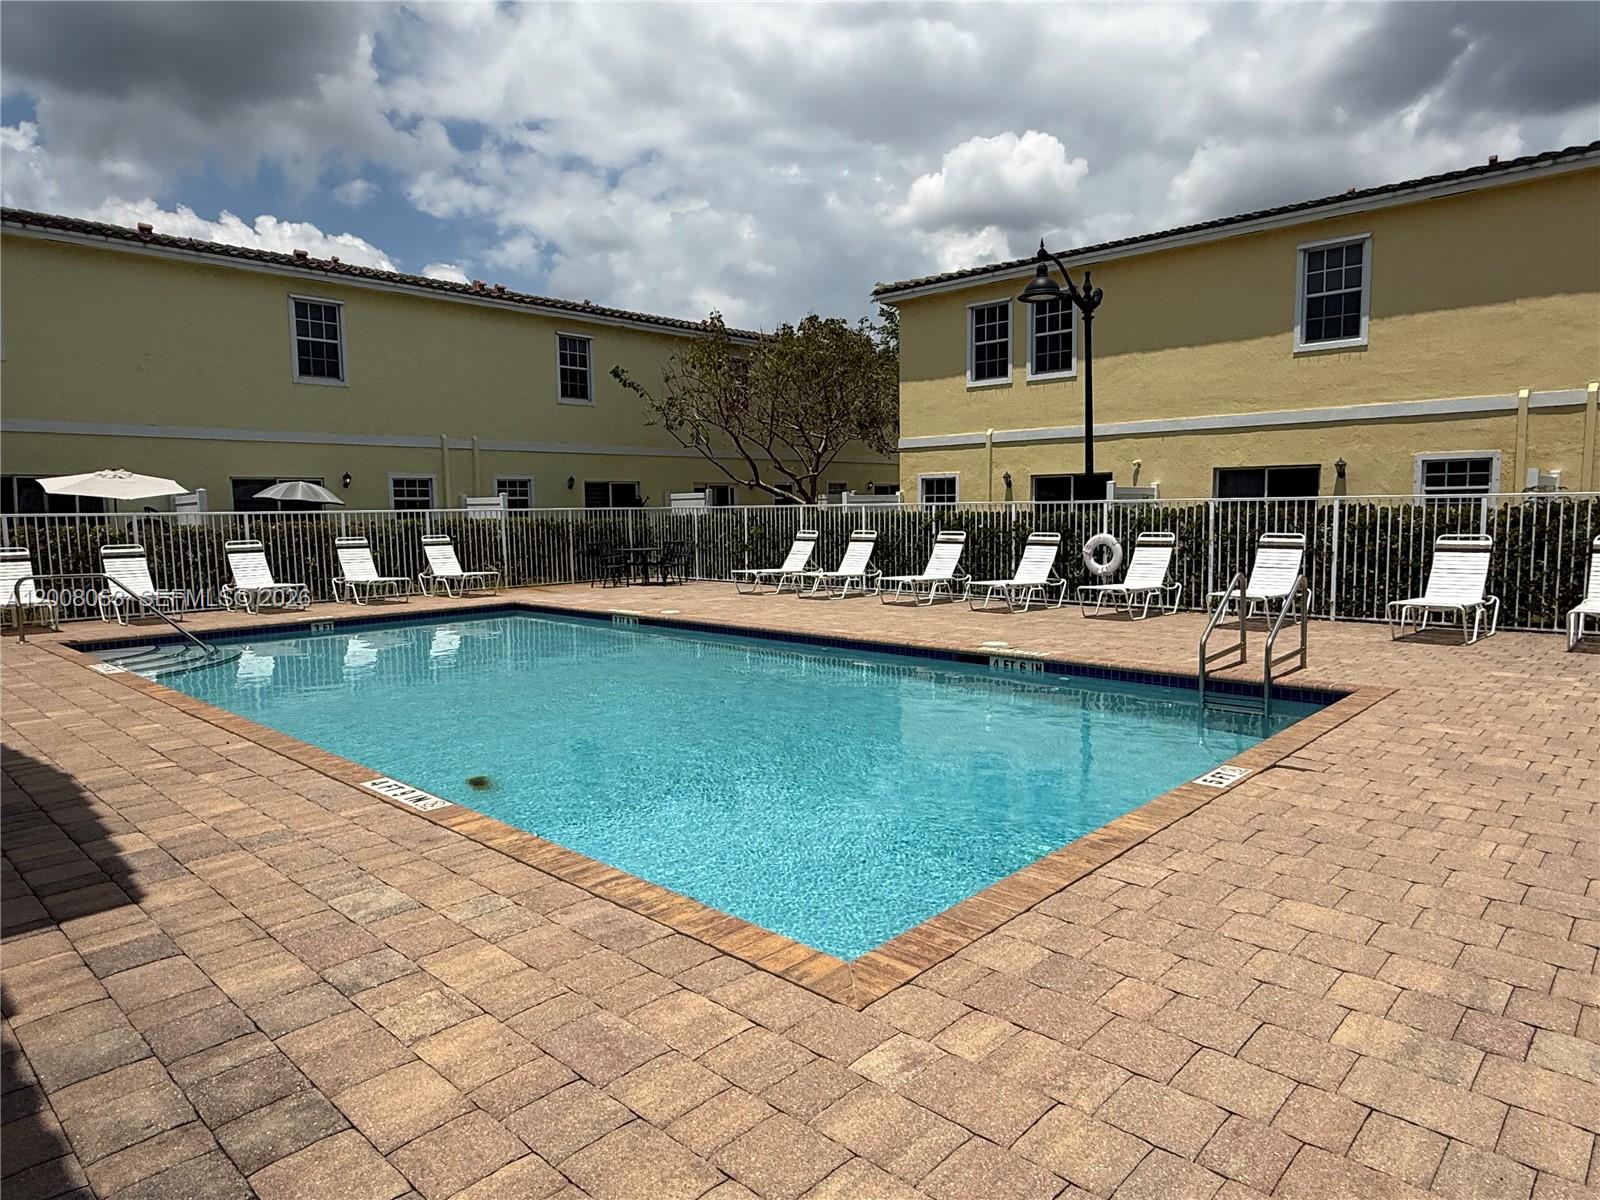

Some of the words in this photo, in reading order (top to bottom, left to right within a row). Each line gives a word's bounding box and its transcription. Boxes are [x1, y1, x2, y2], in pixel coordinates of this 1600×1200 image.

[1210, 771, 1236, 781] FT
[378, 783, 405, 792] FT
[407, 794, 431, 804] IN
